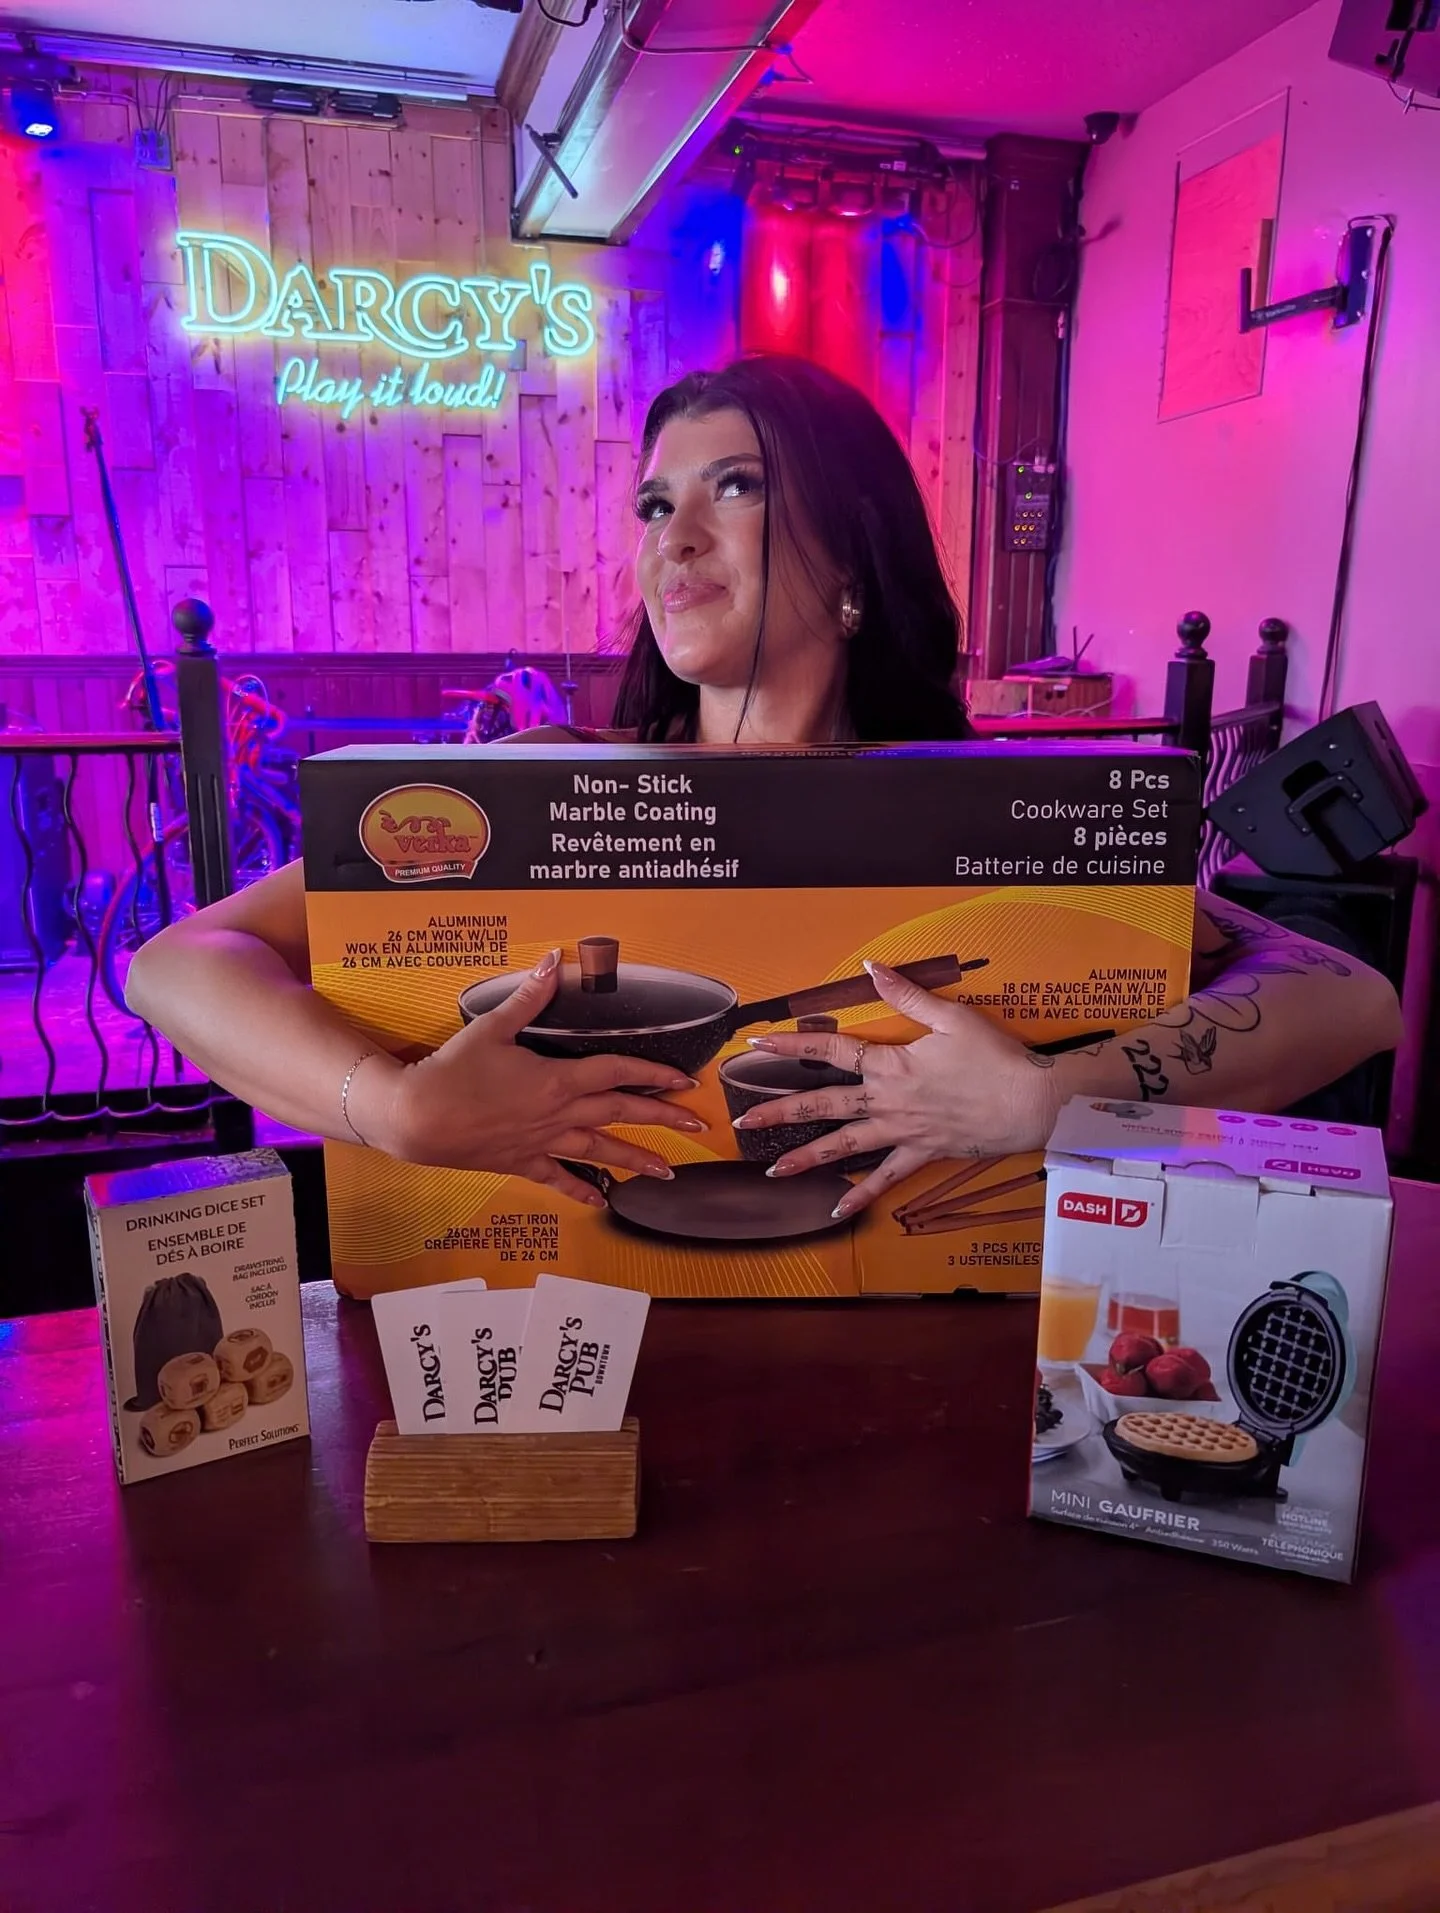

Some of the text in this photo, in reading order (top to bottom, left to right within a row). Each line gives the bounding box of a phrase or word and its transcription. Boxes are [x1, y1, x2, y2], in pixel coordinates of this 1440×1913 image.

[175, 230, 597, 359] DARCY'S
[277, 357, 507, 420] Play it loud!
[573, 774, 693, 795] Non- Stick
[1108, 769, 1170, 790] 8 Pcs
[549, 802, 717, 826] Marble Coating
[1011, 798, 1169, 820] Cookware Set
[552, 831, 716, 852] Revêtement en
[1073, 824, 1168, 851] 8 pièces
[394, 863, 466, 877] PREMIUM QUALITY
[529, 857, 740, 879] marbre antiadhésif
[955, 856, 1165, 876] Batterie de cuisine
[428, 915, 507, 928] ALUMINIUM
[387, 929, 508, 943] 26 CM WOK W/LID
[345, 941, 509, 955] WOK EN ALUMINIUM DE
[342, 955, 509, 968] 26 CM AVEC COUVERCLE
[1089, 968, 1168, 981] ALUMINIUM
[1003, 982, 1167, 996] 18 CM SAUCE PAN W/LID
[1042, 994, 1060, 1006] EN
[1064, 994, 1142, 1006] ALUMINIUM
[1147, 994, 1165, 1006] DE
[1003, 1008, 1016, 1020] 18
[1020, 1008, 1040, 1019] CM
[1044, 1008, 1080, 1019] AVEC
[126, 1194, 267, 1232] DRINKING DICE SET
[1063, 1199, 1107, 1216] DASH
[490, 1213, 559, 1226] CAST IRON
[147, 1221, 248, 1252] ENSEMBLE DE
[446, 1227, 480, 1239] 26CM
[532, 1226, 559, 1238] PAN
[494, 1238, 512, 1249] EN
[516, 1237, 559, 1249] FONTE
[155, 1238, 245, 1266] DÉS À BOIRE
[500, 1250, 559, 1261] DE 26 CM
[970, 1242, 979, 1254] 3
[982, 1242, 1008, 1253] PCS
[947, 1254, 1040, 1266] 3 USTENSILES
[410, 1323, 447, 1423] DARCY'S
[471, 1327, 500, 1425] DARCY'S
[538, 1316, 583, 1415] DARCY'S
[568, 1341, 600, 1397] PUB
[228, 1423, 300, 1451] PERFECT SOLUTIONS
[1051, 1489, 1201, 1532] MINI GAUFRIER
